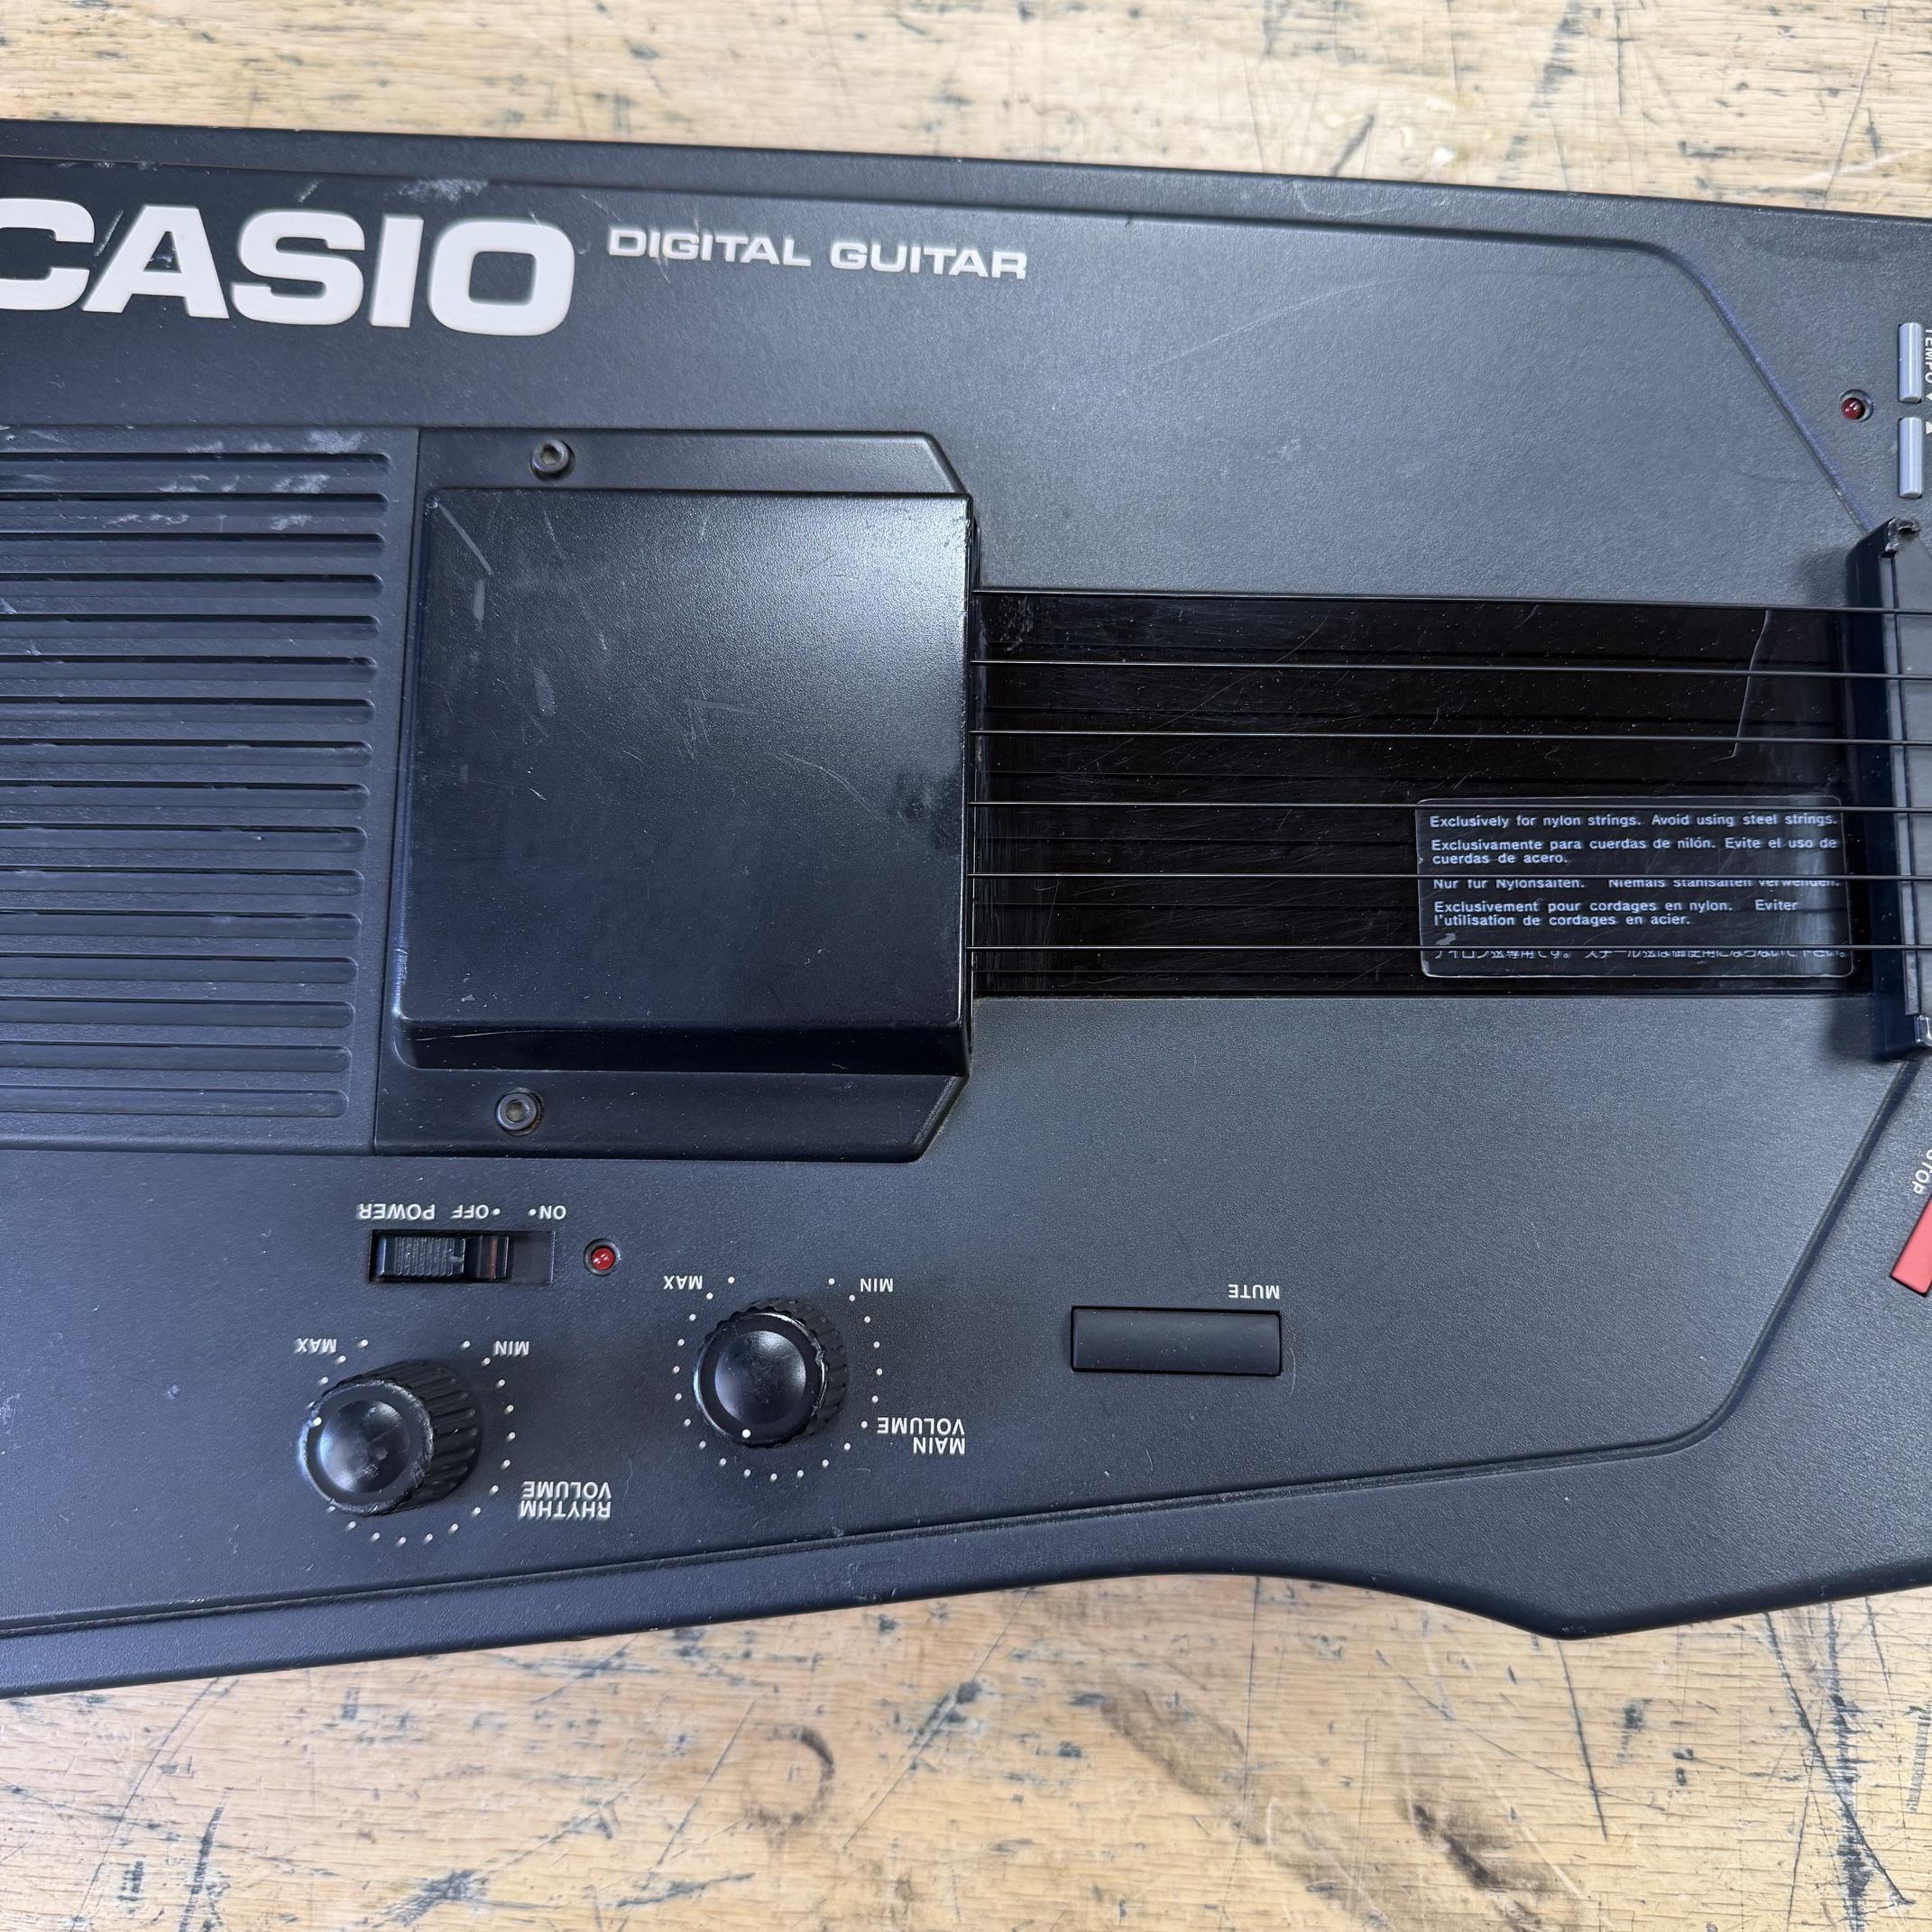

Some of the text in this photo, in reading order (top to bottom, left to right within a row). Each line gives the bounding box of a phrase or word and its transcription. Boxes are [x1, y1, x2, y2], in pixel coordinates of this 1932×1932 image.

[608, 227, 1028, 281] DIGITAL GUITAR
[0, 197, 575, 337] CASIO
[1430, 812, 1837, 829] Exclusively for nylon strings. Avoid using steel strings.
[1431, 836, 1837, 851] Exclusivamente para cuerdas de nilón. Evite el uso de
[1432, 852, 1569, 865] cuerdas de acero.
[1433, 879, 1458, 889] Nur
[1434, 898, 1800, 916] Exclusivement pour cordages en nylon. Eviter
[1434, 913, 1690, 927] l'utilisation de cordages en acier.
[356, 1203, 436, 1220] POWER
[452, 1204, 490, 1219] OFF
[538, 1204, 566, 1219] ON
[662, 1274, 704, 1291] MAX
[860, 1277, 894, 1293] MIN
[1228, 1283, 1280, 1300] MUTE
[294, 1338, 337, 1354] MAX
[493, 1340, 530, 1357] MIN
[877, 1416, 966, 1436] VOLUME
[913, 1436, 966, 1455] MAIN
[520, 1480, 612, 1499] VOLUME
[519, 1500, 612, 1521] RHYTHM
